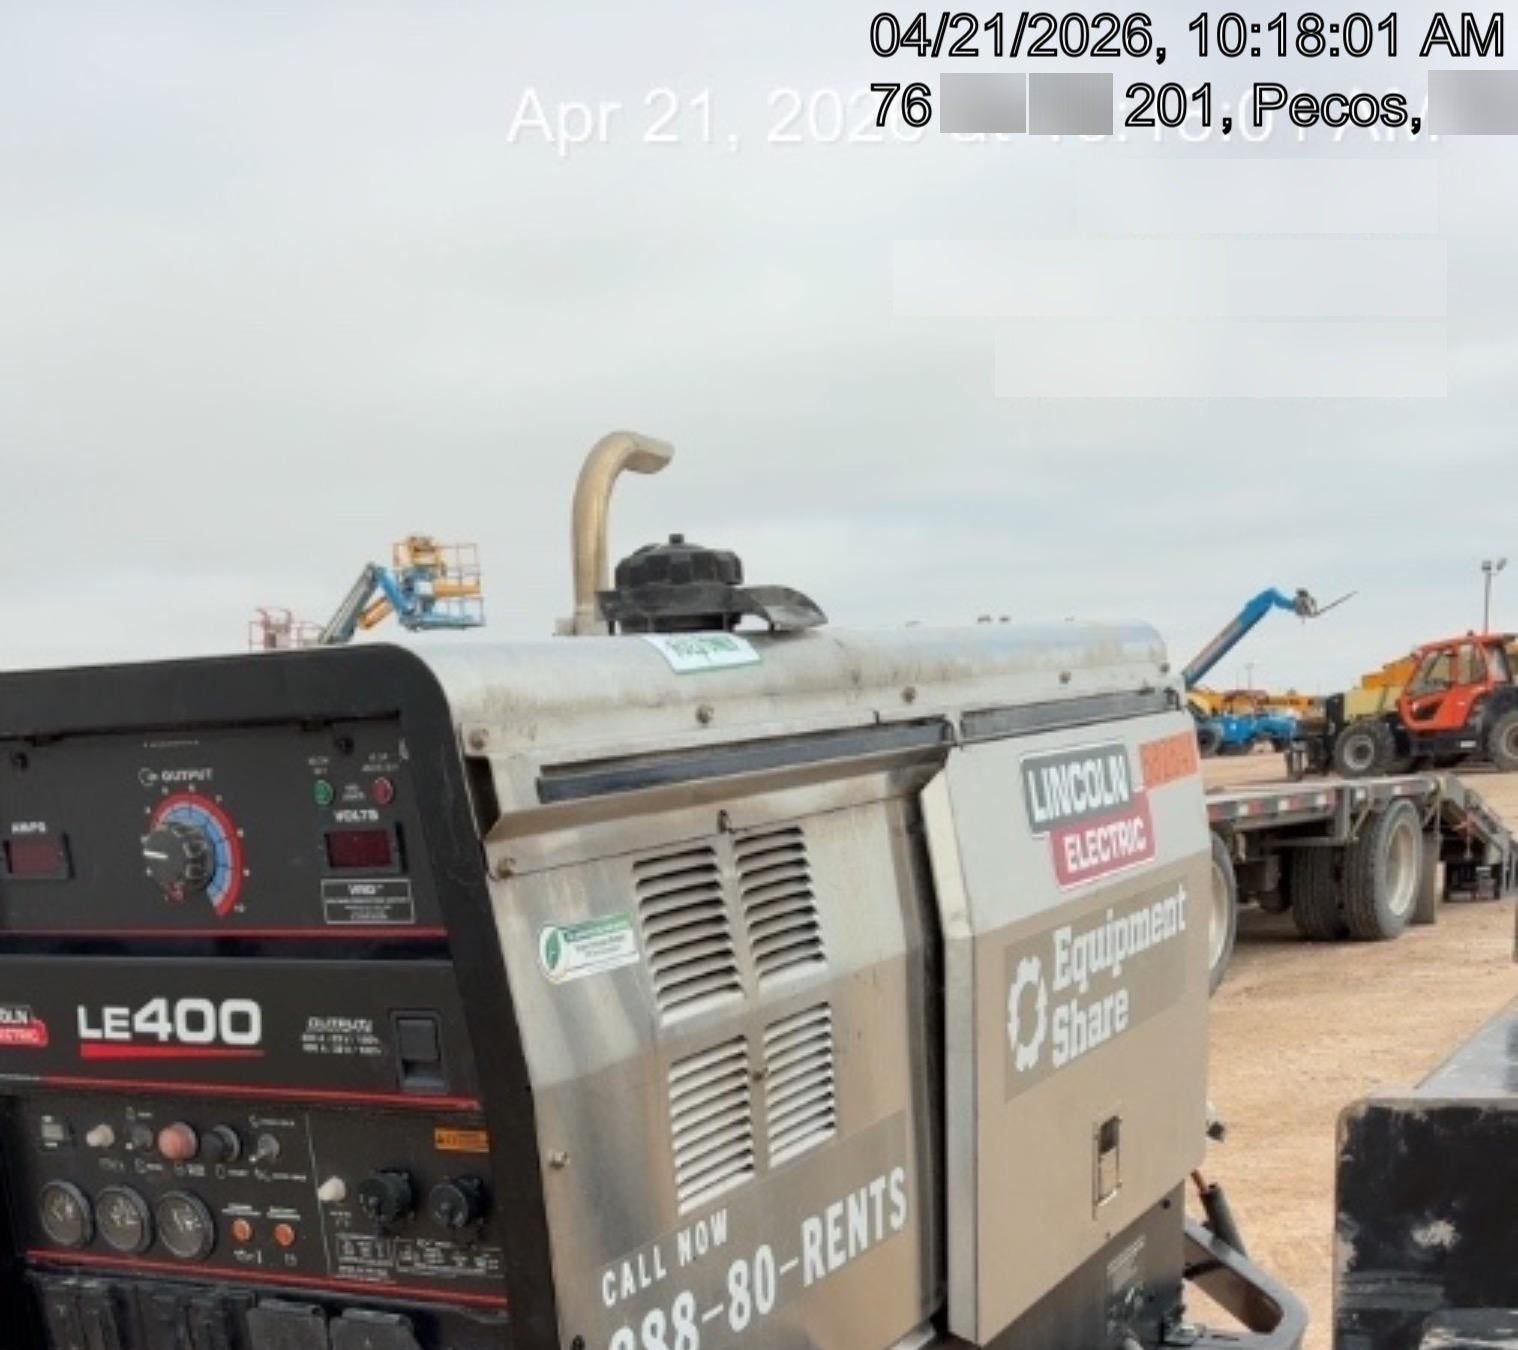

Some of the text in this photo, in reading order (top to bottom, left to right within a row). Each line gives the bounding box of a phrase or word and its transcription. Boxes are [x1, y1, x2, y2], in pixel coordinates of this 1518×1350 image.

[1027, 753, 1131, 822] LINCOLN
[1063, 815, 1148, 874] ELECTRIC
[1052, 882, 1188, 995] Equipment
[77, 998, 262, 1045] LE400
[1051, 986, 1131, 1068] Share
[601, 1208, 728, 1307] CALL NOW
